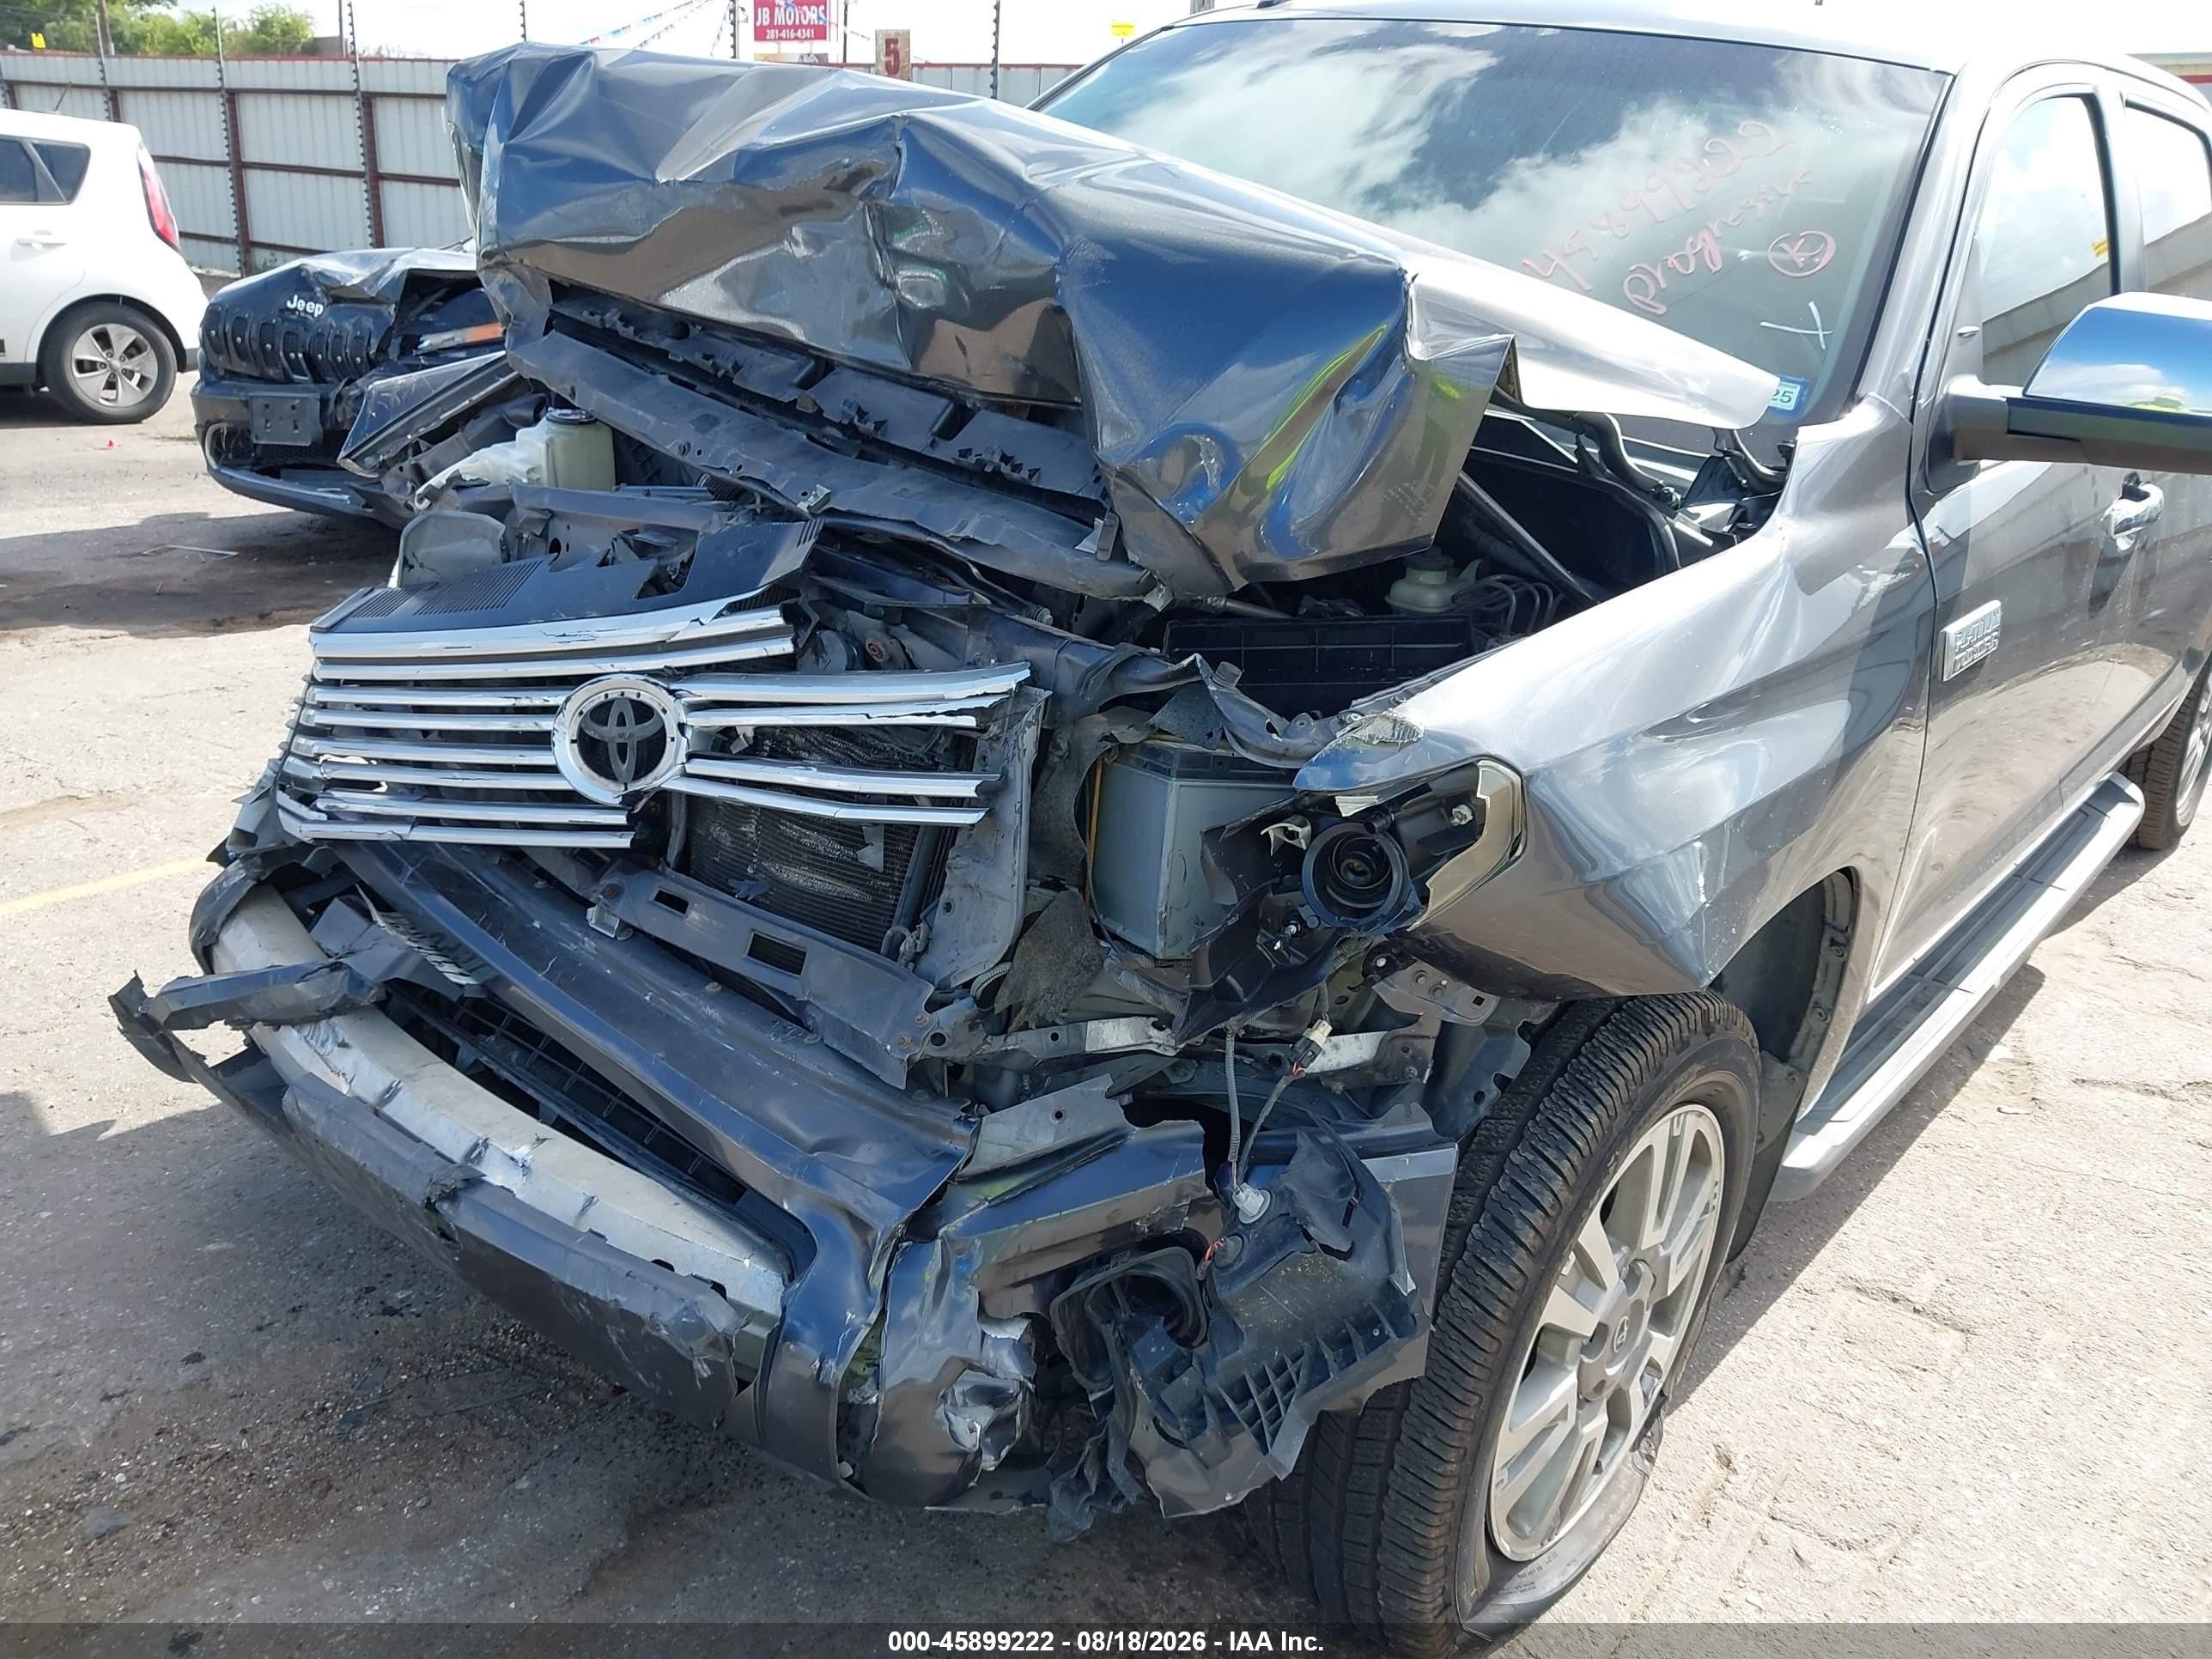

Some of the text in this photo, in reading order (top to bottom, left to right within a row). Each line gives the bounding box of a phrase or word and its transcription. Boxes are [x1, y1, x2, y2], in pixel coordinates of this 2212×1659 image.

[756, 5, 826, 26] JB MOTORS
[766, 28, 815, 40] 281-416-4341
[884, 38, 901, 76] 5
[286, 294, 324, 318] Jeep
